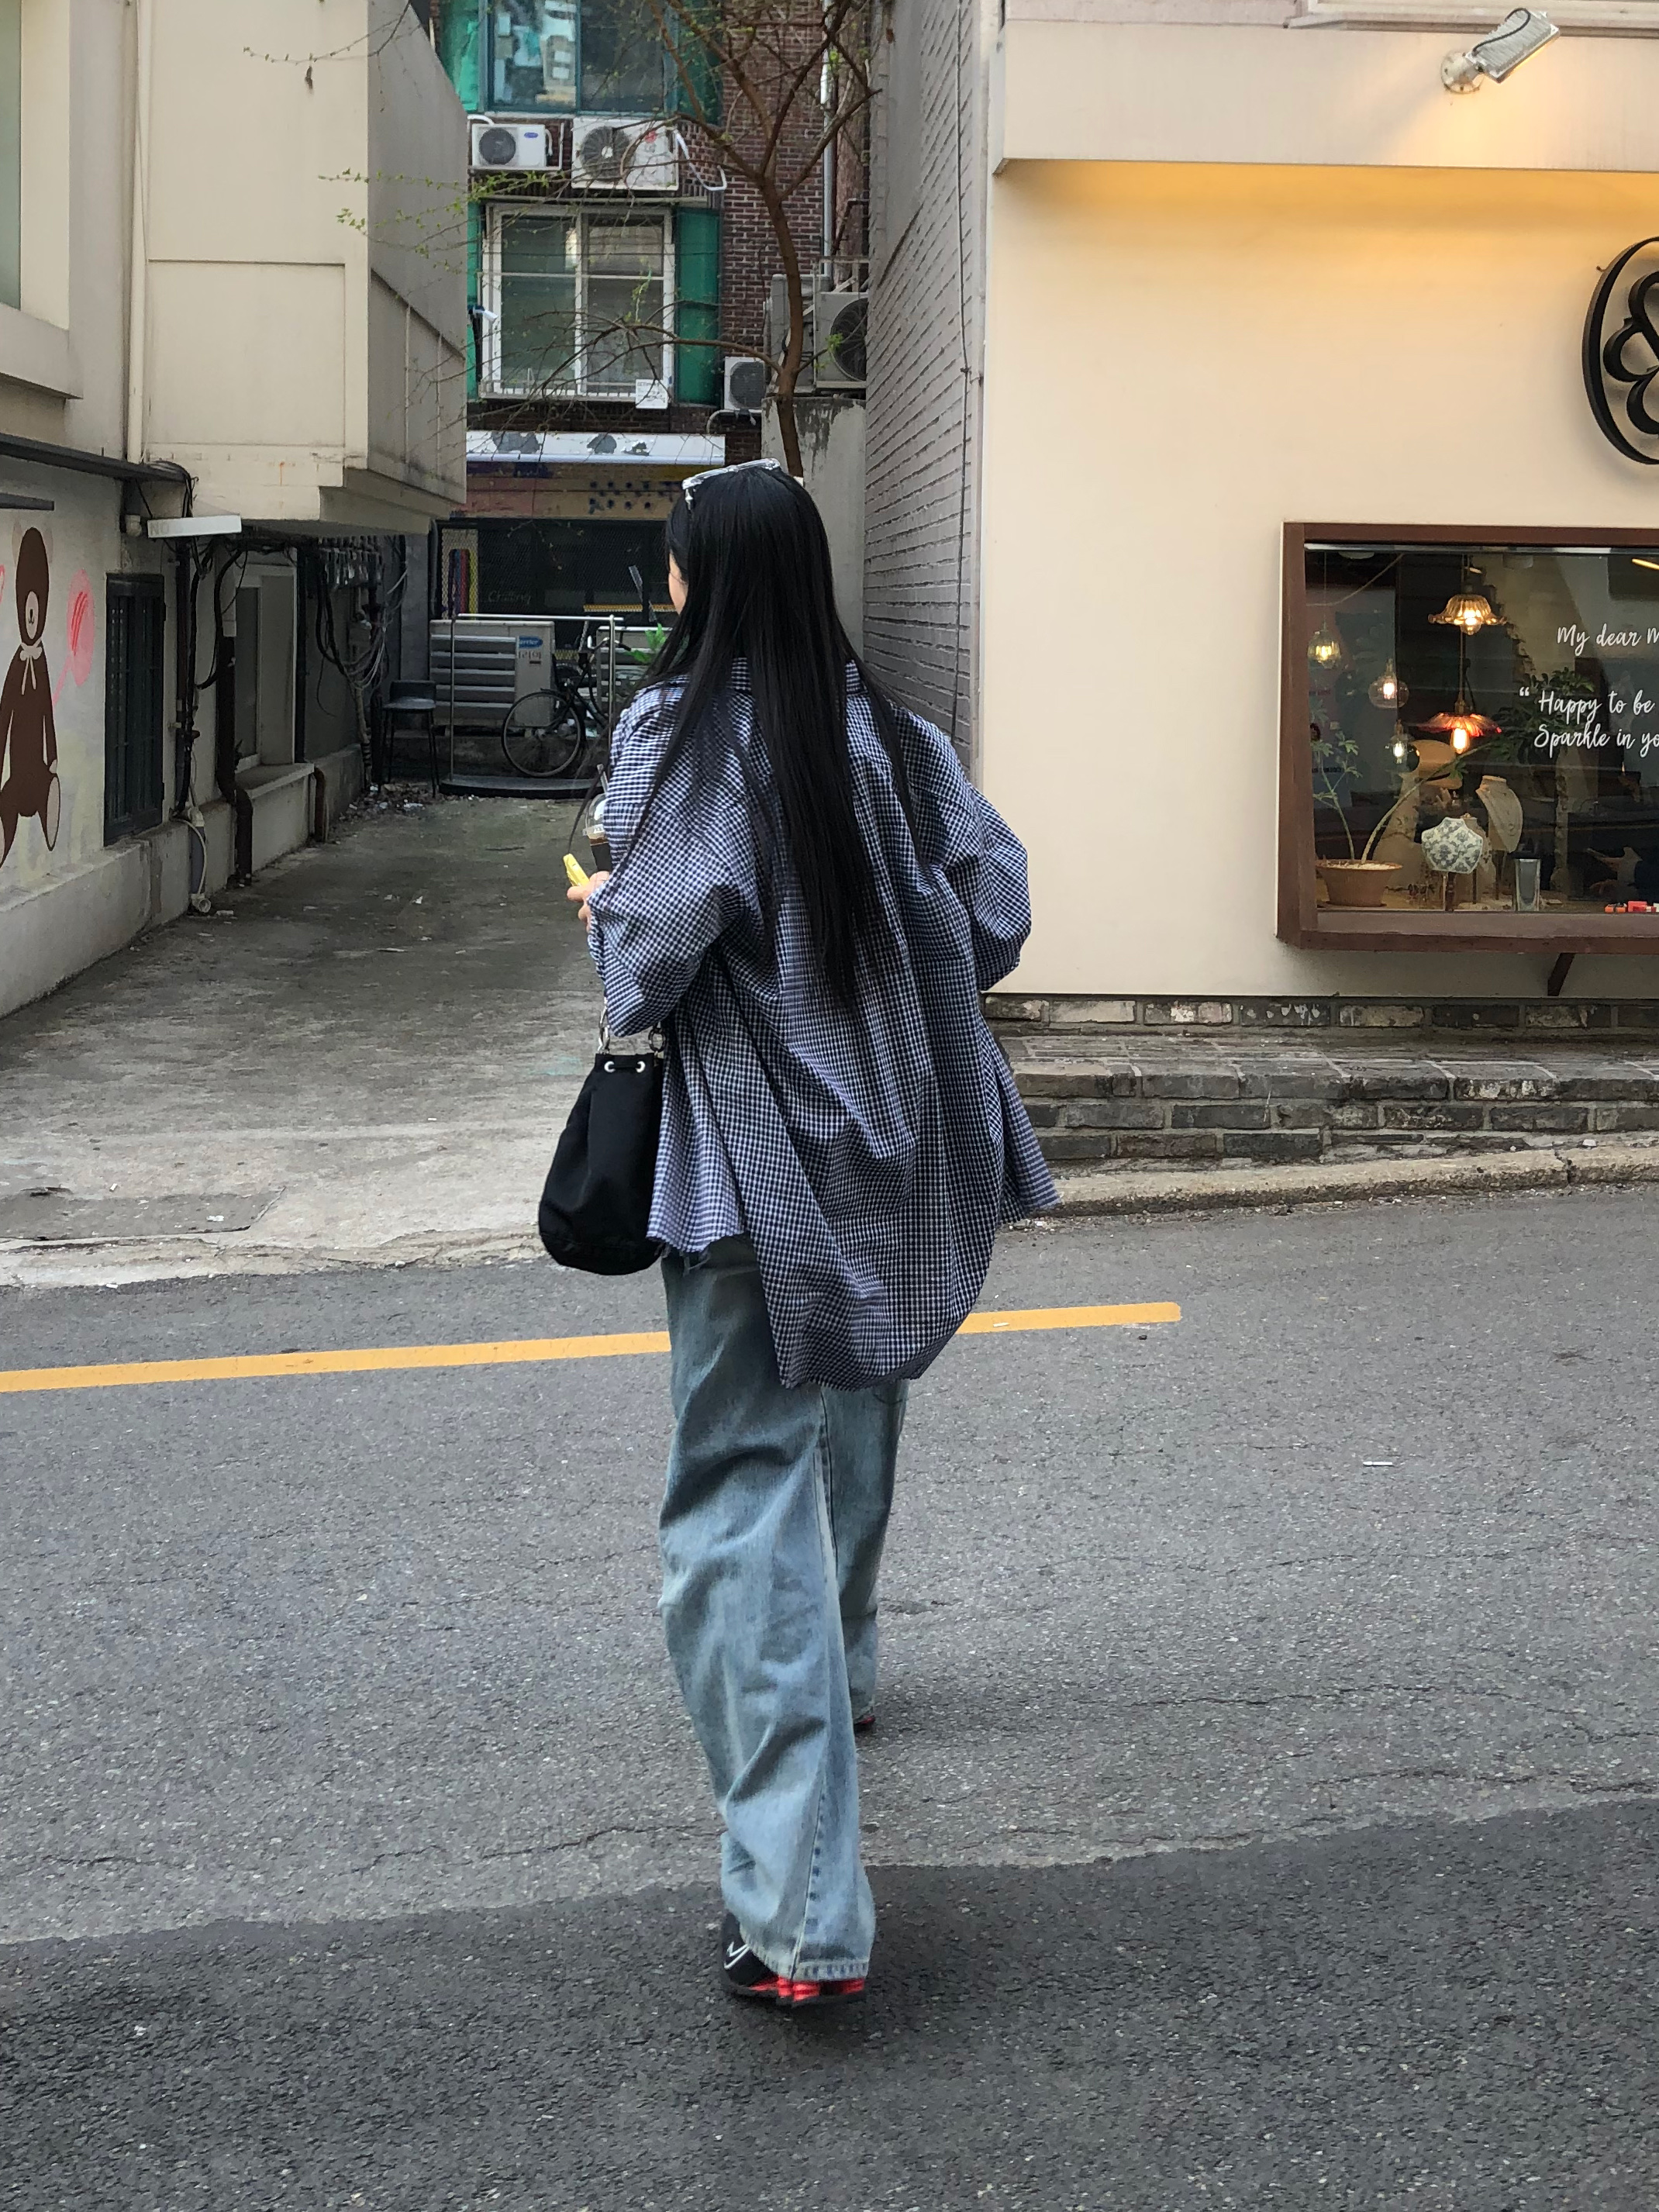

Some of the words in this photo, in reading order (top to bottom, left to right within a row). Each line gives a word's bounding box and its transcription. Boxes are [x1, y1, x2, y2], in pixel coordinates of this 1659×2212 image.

[1557, 624, 1590, 657] My
[1595, 623, 1642, 647] dear
[1538, 690, 1602, 724] Happy
[1608, 691, 1627, 713] to
[1633, 689, 1655, 716] be
[1533, 722, 1610, 758] Sparkle
[1616, 729, 1636, 749] in
